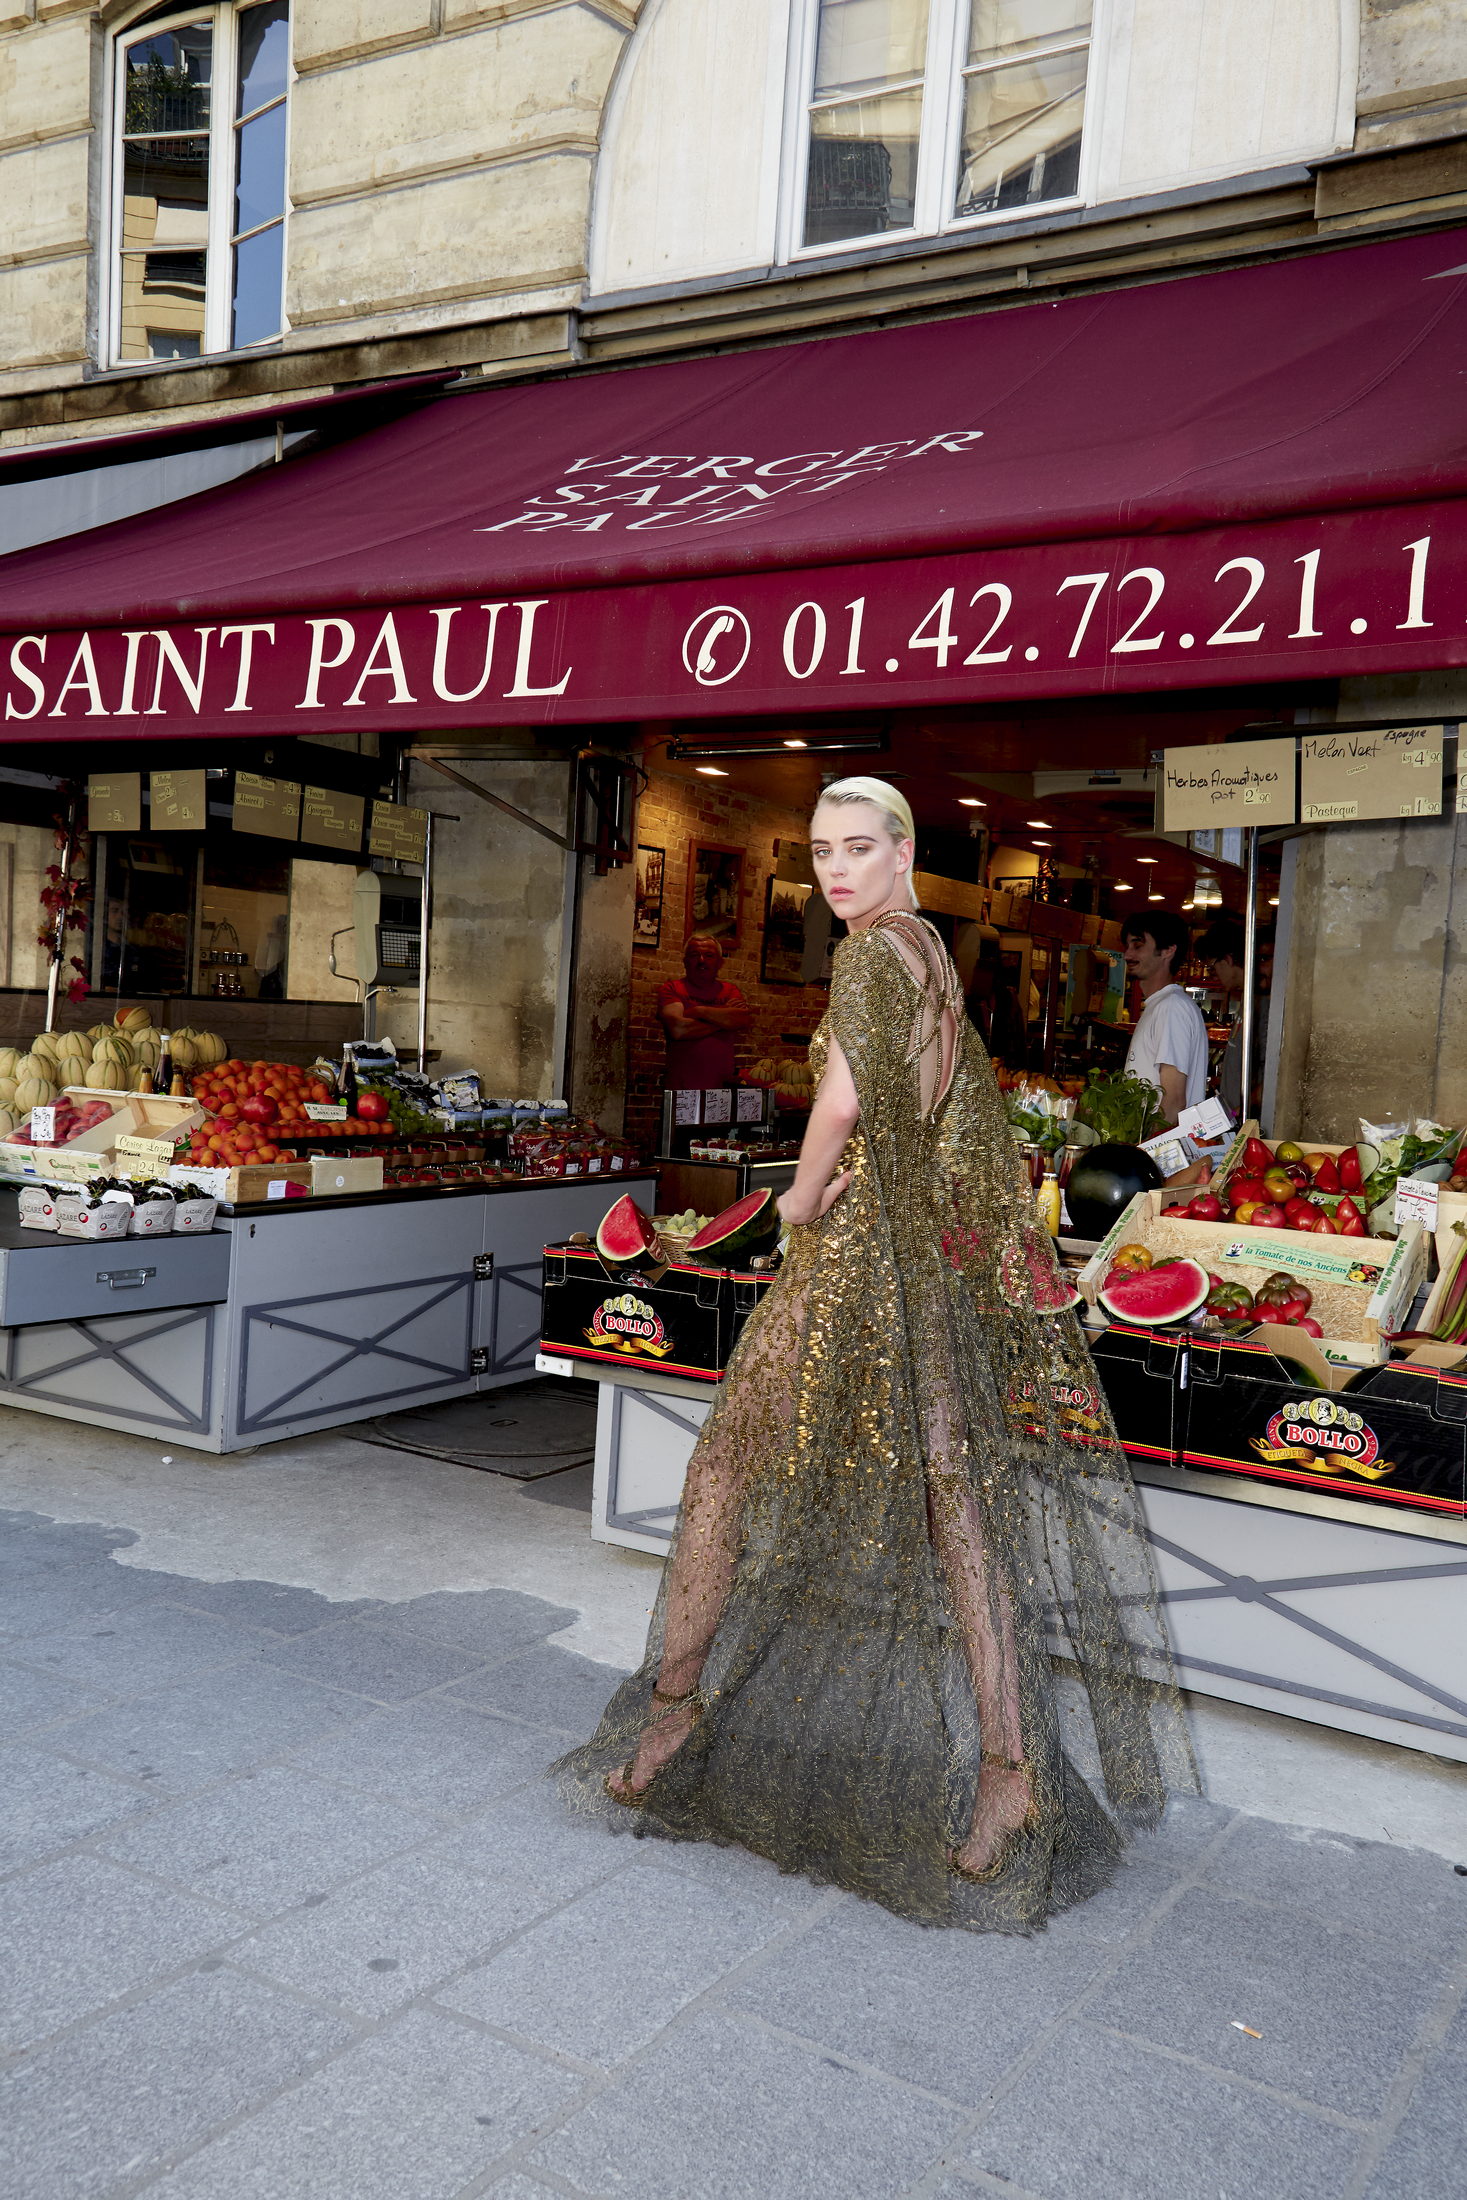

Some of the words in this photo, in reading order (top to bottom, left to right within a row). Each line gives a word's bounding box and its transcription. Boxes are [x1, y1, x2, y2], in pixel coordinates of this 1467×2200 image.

[563, 430, 985, 478] VERGER
[524, 465, 888, 506] SAINT
[474, 503, 775, 532] PAUL
[782, 536, 1467, 686] 01.42.72.21.1
[5, 623, 275, 721] SAINT
[294, 599, 573, 709] PAUL
[1305, 737, 1346, 759] Melon
[1383, 728, 1427, 746] Espagne
[1167, 769, 1208, 789] Herbes
[1211, 765, 1279, 789] Aromatiques
[1210, 787, 1237, 805] pot
[20, 1204, 42, 1214] LAZARE
[1255, 1247, 1284, 1261] Tomate
[1286, 1254, 1296, 1263] de
[1297, 1258, 1312, 1267] nos
[1314, 1262, 1348, 1274] Anciens
[606, 1315, 653, 1336] BOLLO
[1267, 1416, 1280, 1442] SINCE
[1286, 1423, 1362, 1452] BOLLO
[1338, 1457, 1369, 1475] NEGRA
